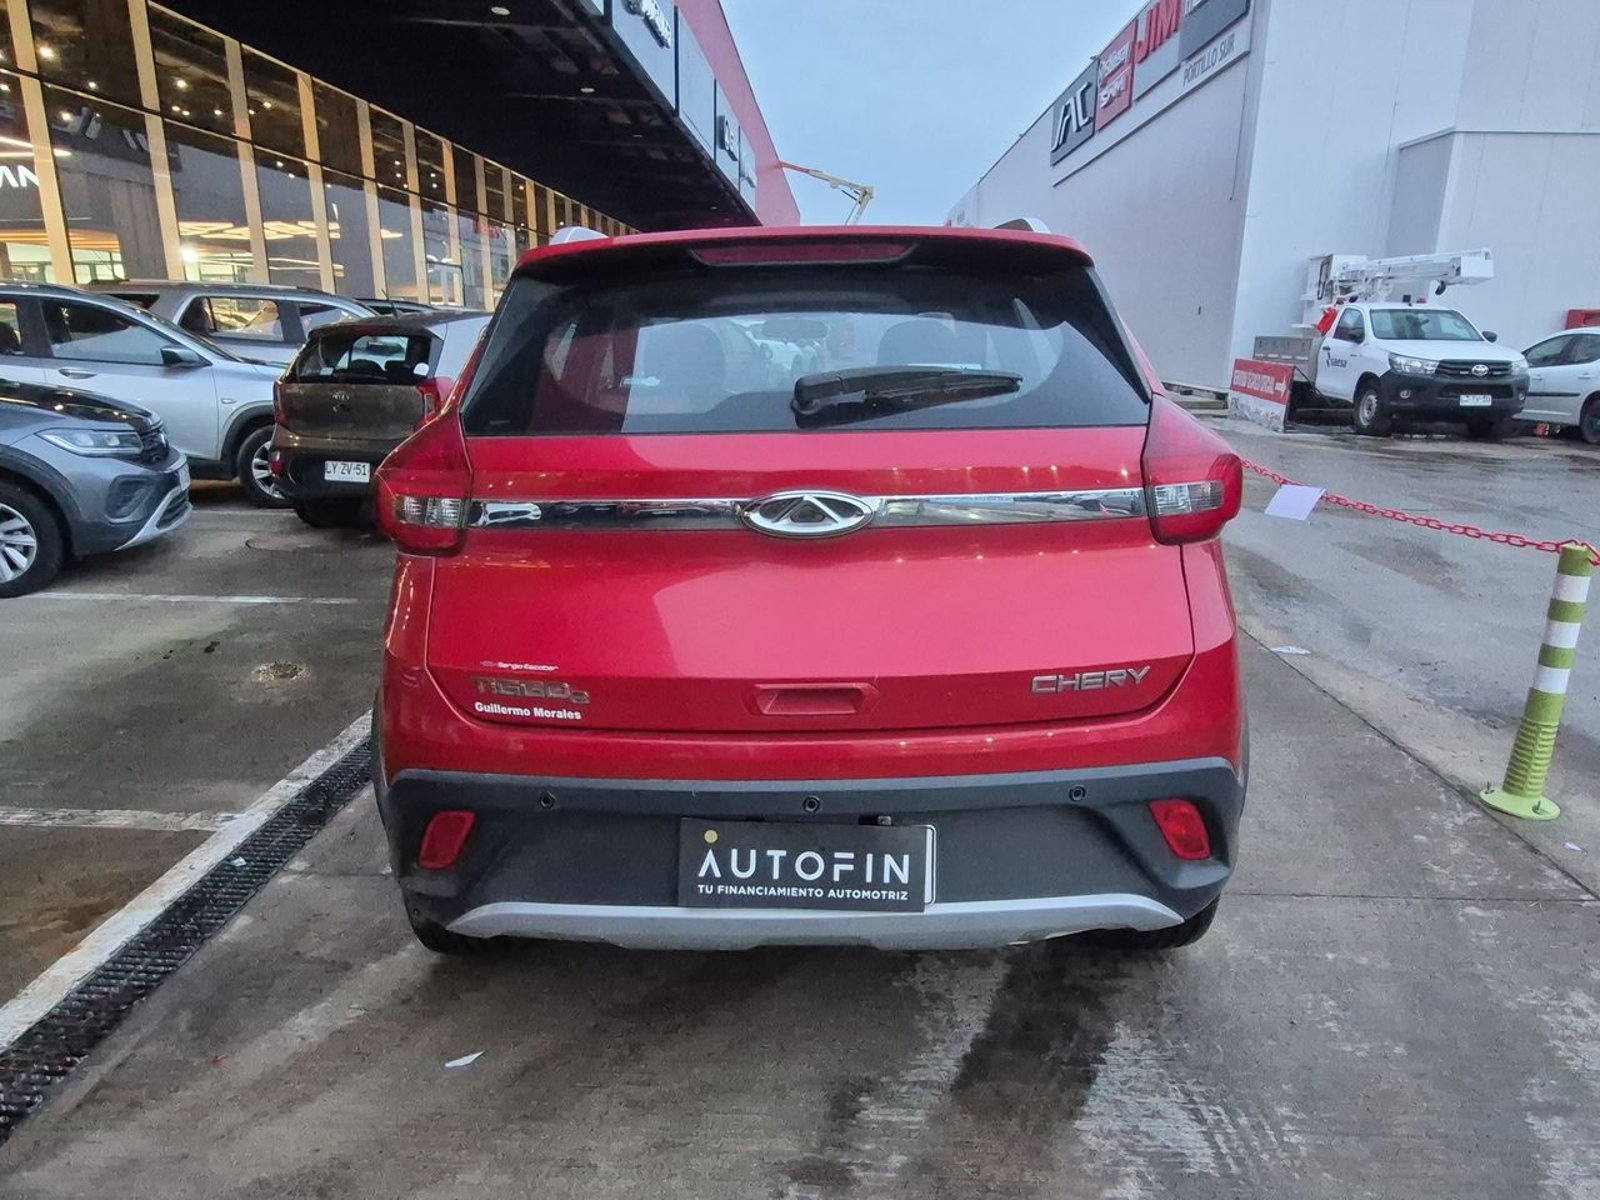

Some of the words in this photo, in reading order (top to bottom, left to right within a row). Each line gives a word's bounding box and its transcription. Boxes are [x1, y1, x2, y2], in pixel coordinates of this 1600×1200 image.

[1183, 48, 1217, 86] PORTILLO
[1219, 33, 1235, 62] SUR
[1031, 665, 1150, 694] CHERY
[474, 701, 531, 716] Guillermo
[533, 707, 582, 720] Morales
[698, 848, 910, 884] AUTOFIN
[698, 884, 714, 895] TU
[717, 885, 824, 898] FINANCIAMIENTO
[827, 889, 909, 901] AUTOMOTRIZ
